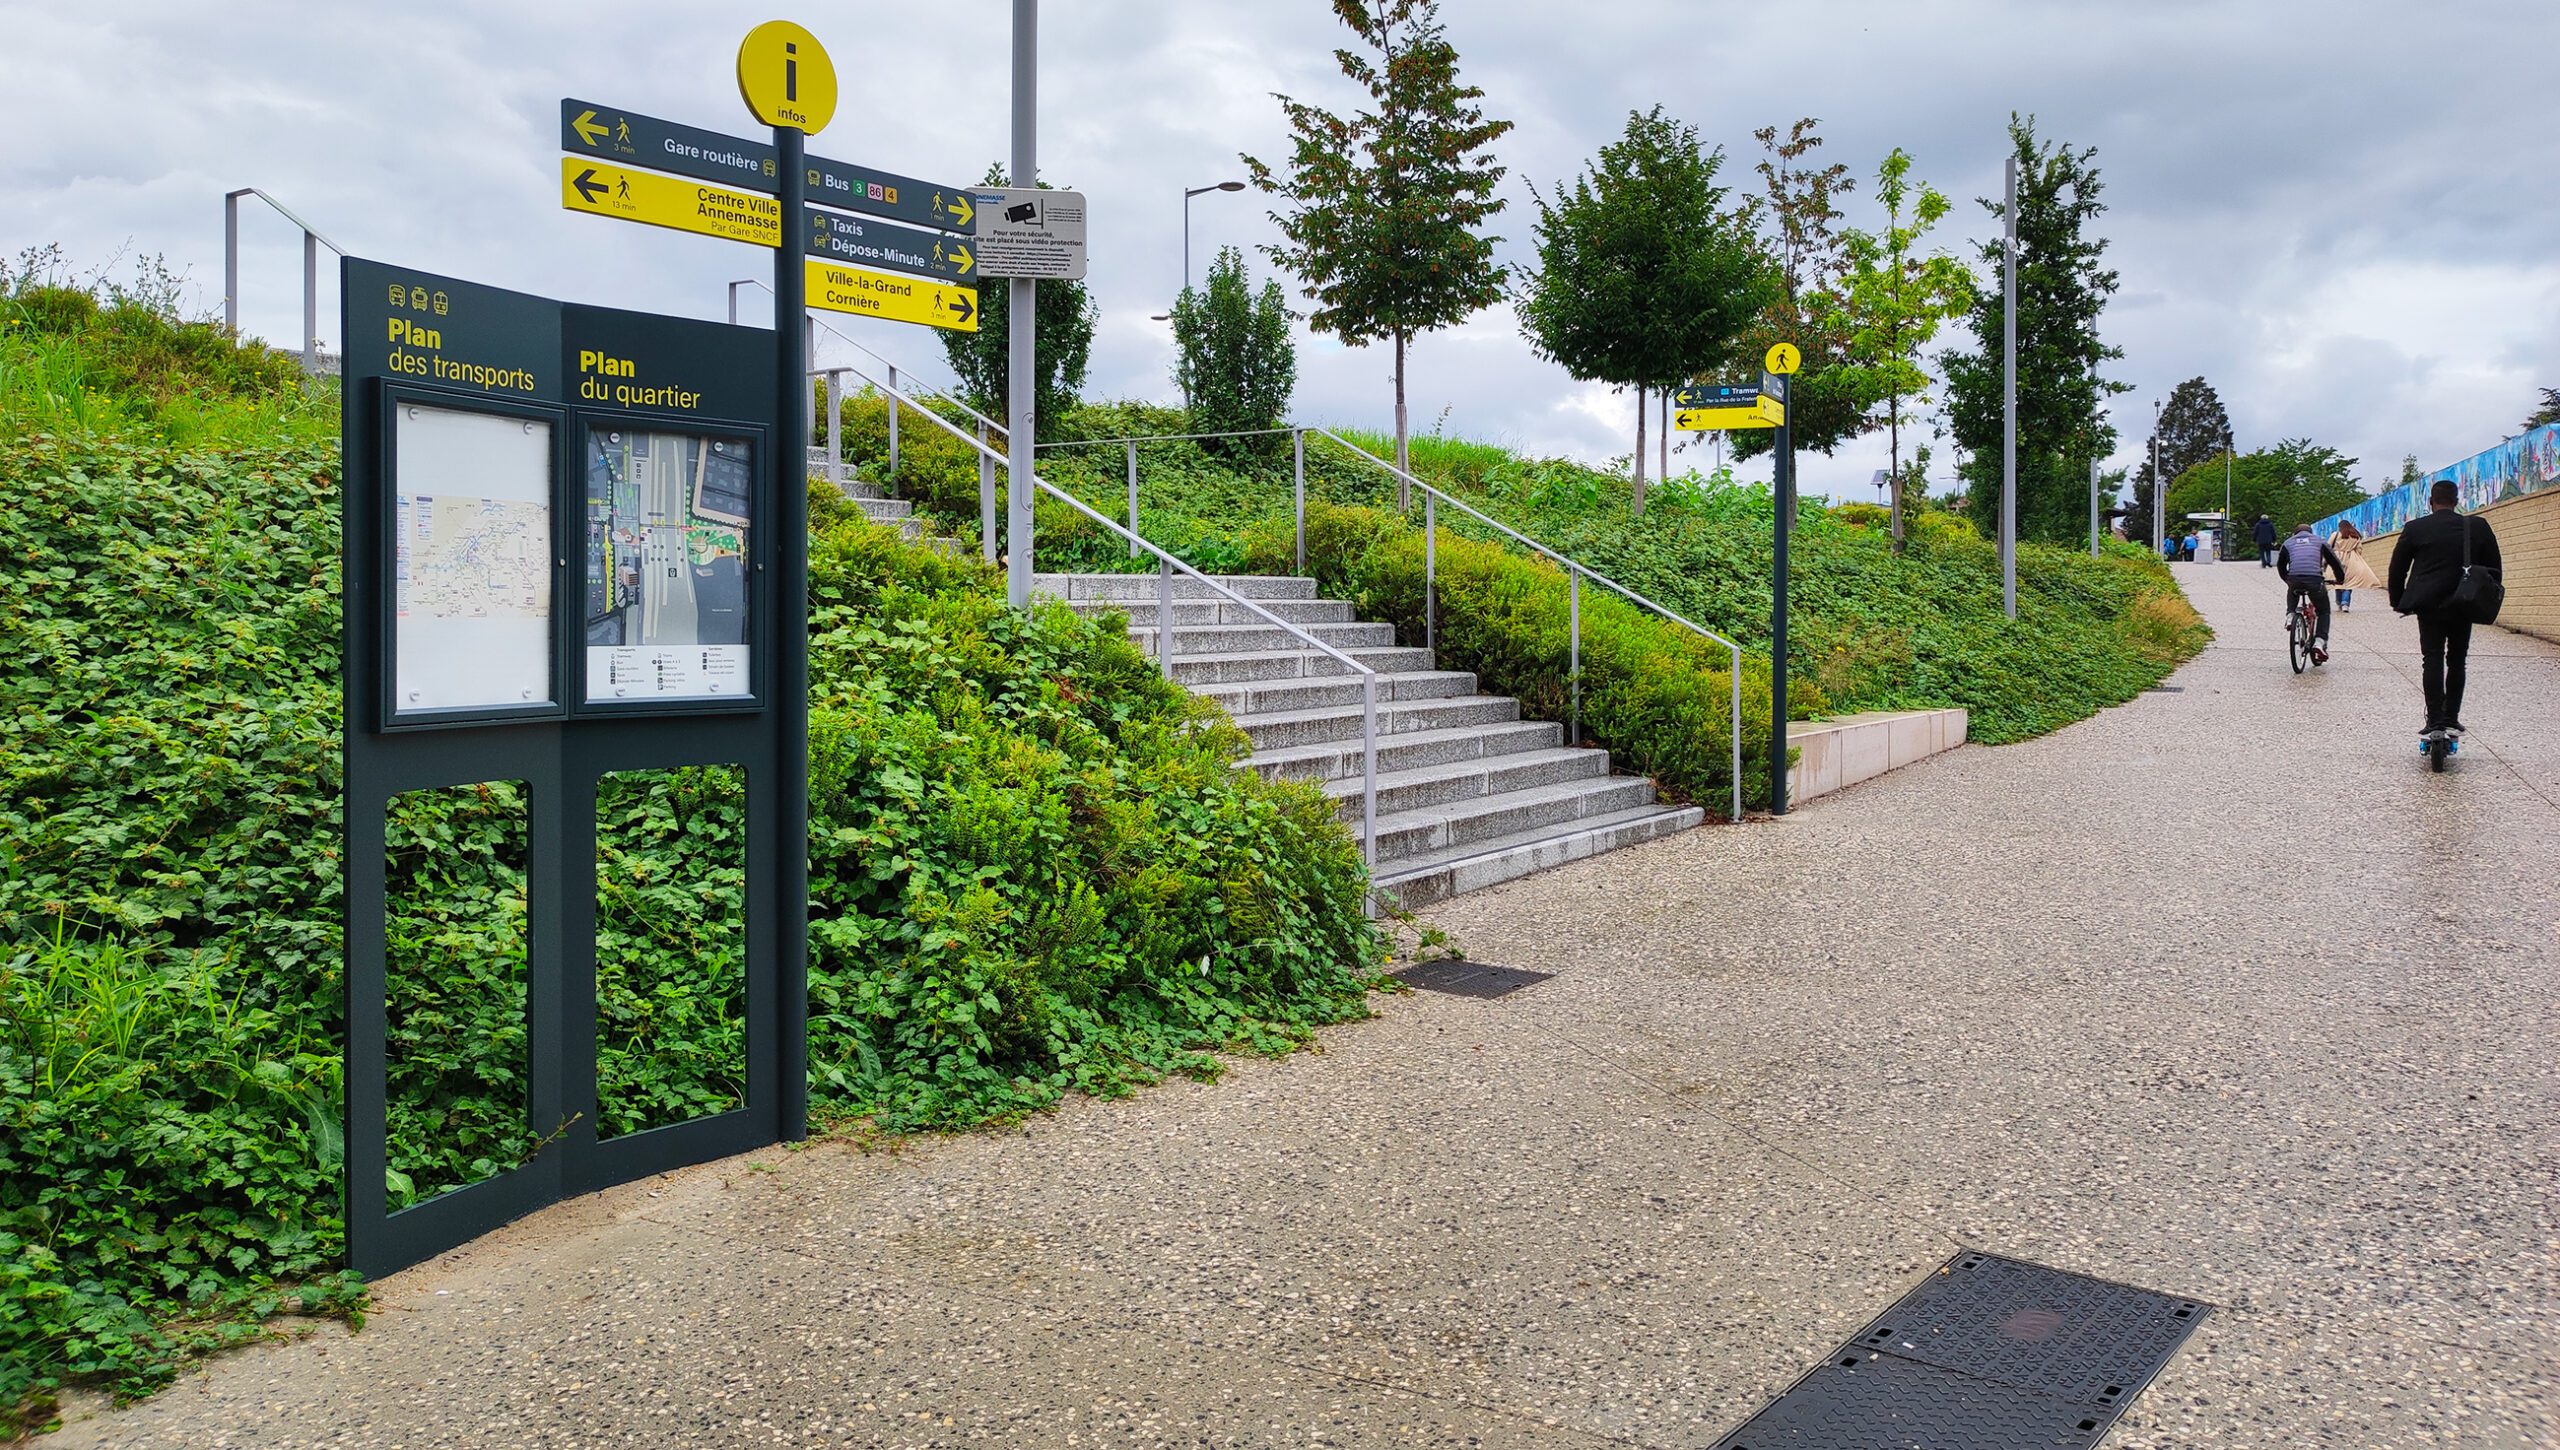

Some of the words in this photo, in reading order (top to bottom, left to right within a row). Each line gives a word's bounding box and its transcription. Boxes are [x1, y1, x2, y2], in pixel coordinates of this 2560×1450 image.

[777, 106, 806, 124] infos
[614, 143, 619, 151] 3
[620, 144, 636, 154] min
[664, 138, 699, 158] Gare
[703, 149, 758, 171] routière
[825, 174, 849, 191] Bus
[869, 185, 882, 198] 86
[887, 190, 894, 200] 4
[612, 200, 621, 210] 13
[622, 201, 636, 211] min
[697, 188, 745, 209] Centre
[748, 198, 778, 216] Ville
[697, 203, 778, 230] Annemasse
[831, 218, 863, 236] Taxis
[934, 213, 945, 222] min
[711, 221, 726, 232] Par
[728, 224, 751, 237] Gare
[753, 230, 778, 242] SNCF
[997, 237, 1014, 245] placé
[1027, 231, 1054, 239] sécurité,
[832, 238, 925, 267] Dépose-Minute
[935, 262, 946, 272] min
[826, 270, 912, 296] Ville-la-Grand
[826, 289, 880, 310] Cornière
[935, 312, 946, 321] min
[388, 317, 441, 350] Plan
[389, 346, 428, 376] des
[433, 354, 534, 391] transports
[580, 350, 635, 378] Plan
[580, 375, 609, 400] du
[616, 384, 701, 409] quartier
[1732, 387, 1759, 395] Tramw
